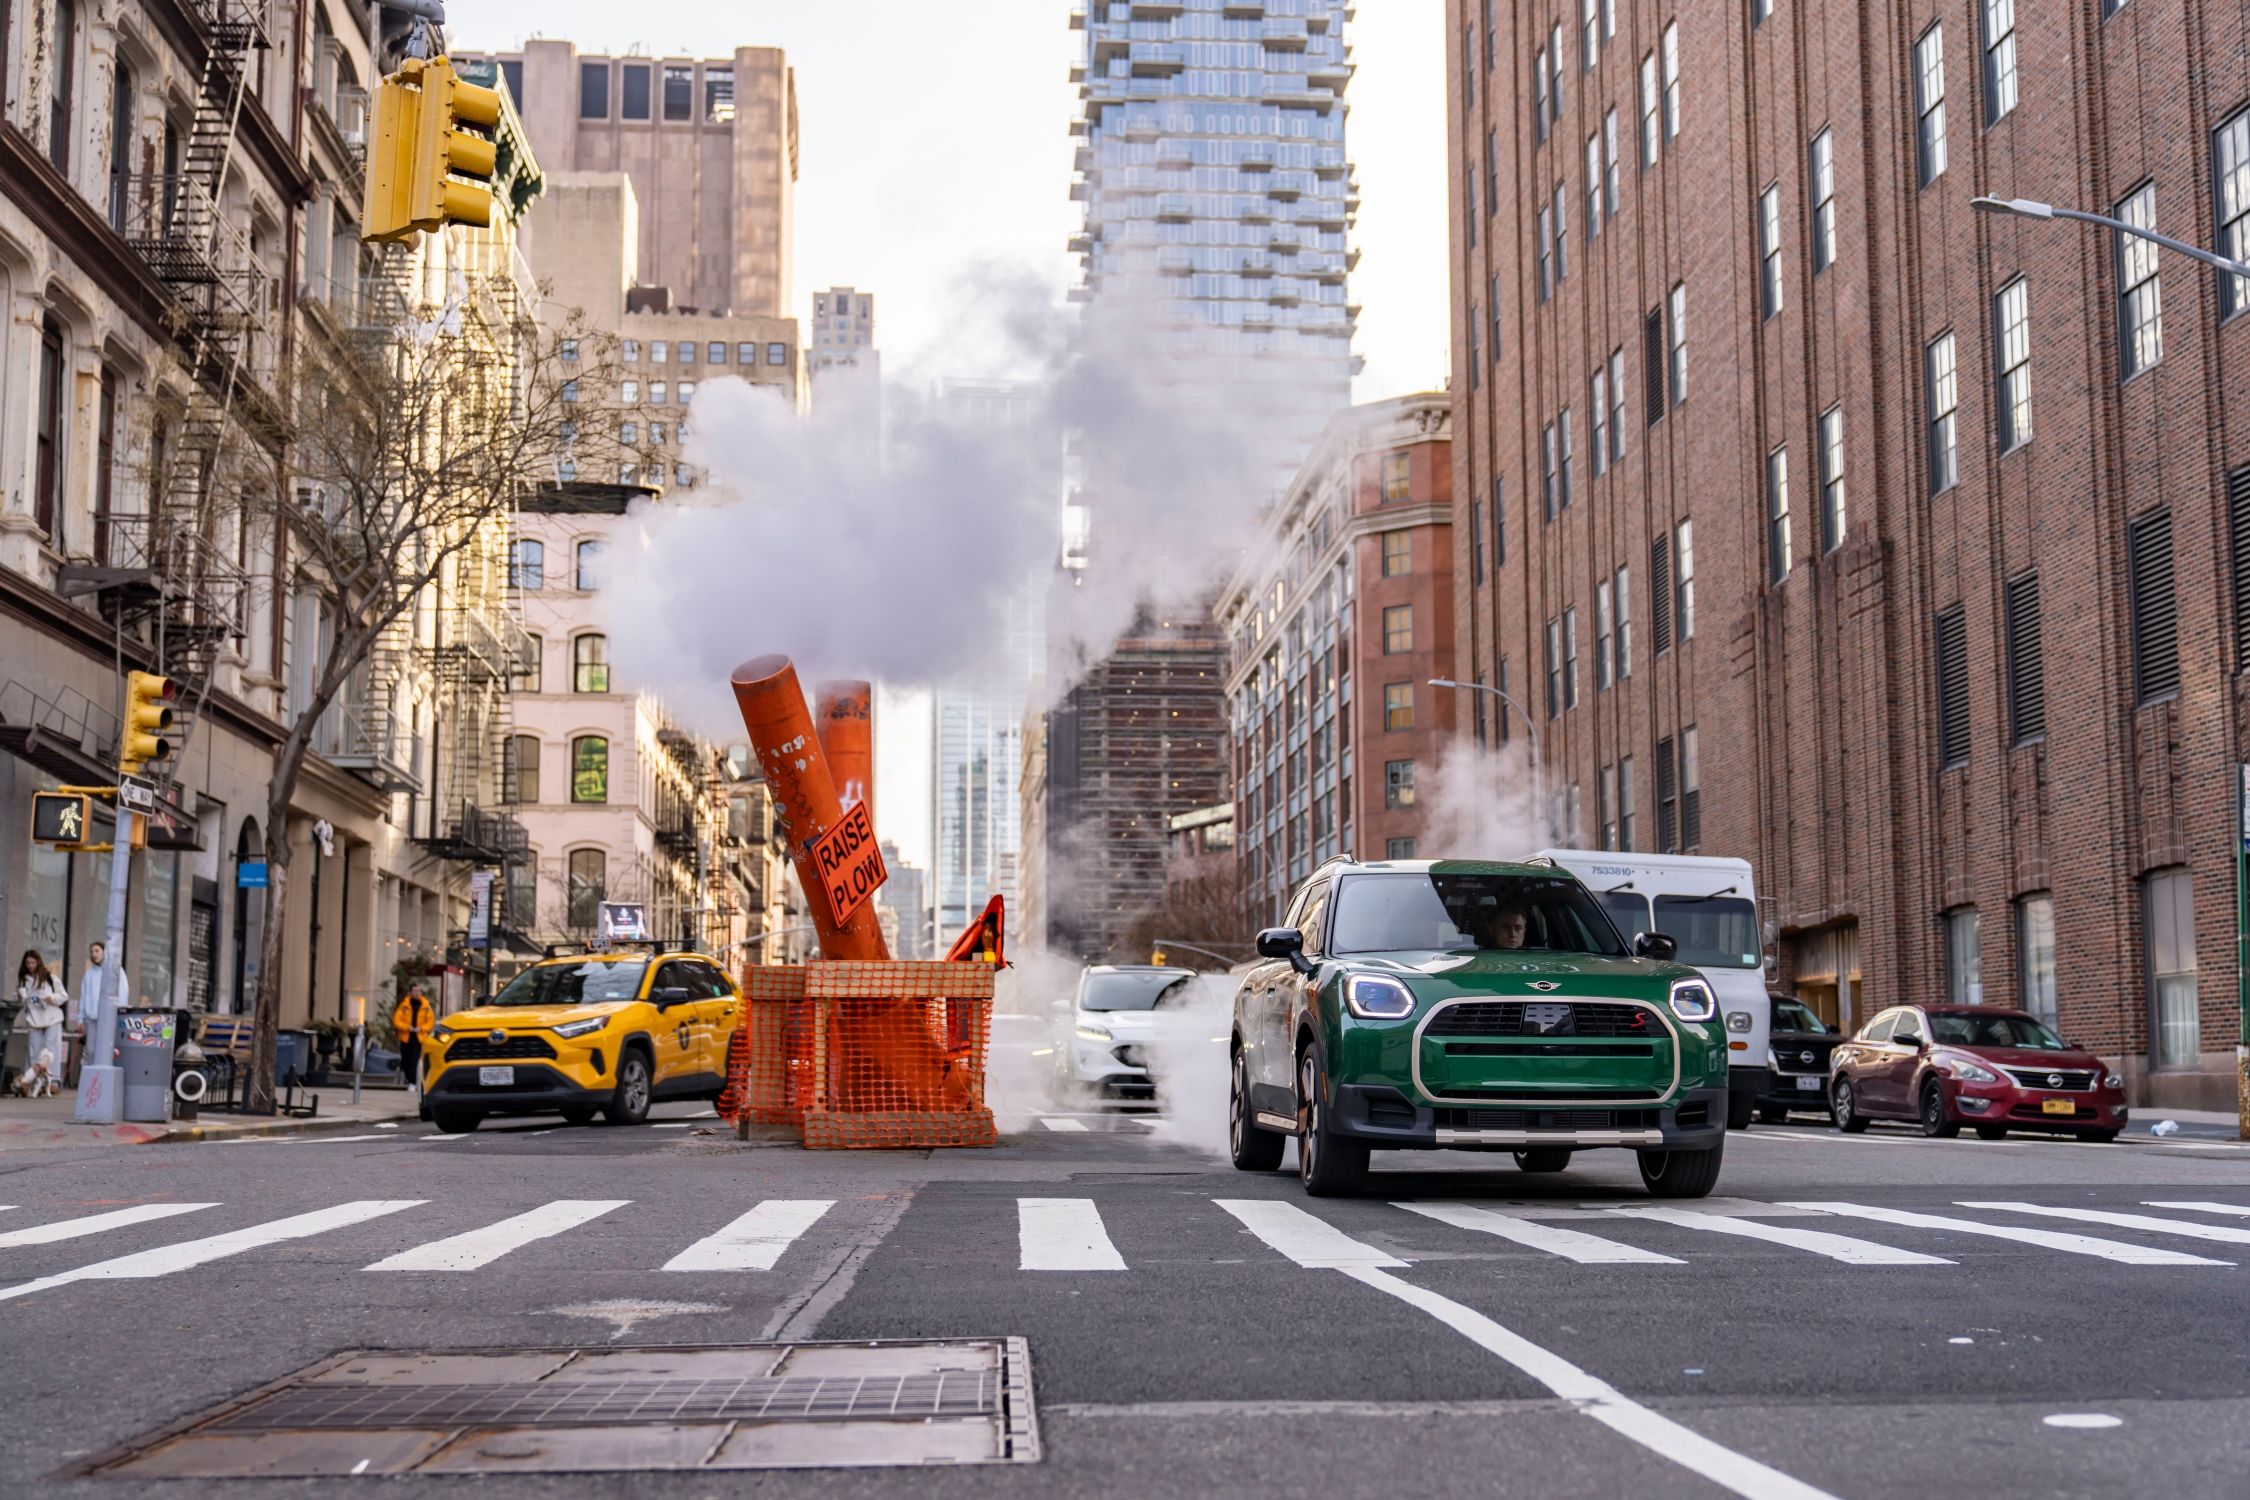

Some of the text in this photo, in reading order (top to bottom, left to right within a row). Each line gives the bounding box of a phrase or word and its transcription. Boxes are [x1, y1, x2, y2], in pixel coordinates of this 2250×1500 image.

[124, 784, 152, 805] ONE WAY
[819, 811, 870, 877] RAISE
[833, 849, 881, 916] PLOW
[1591, 866, 1631, 876] 7533810
[31, 912, 58, 943] RKS
[1630, 1011, 1648, 1028] S
